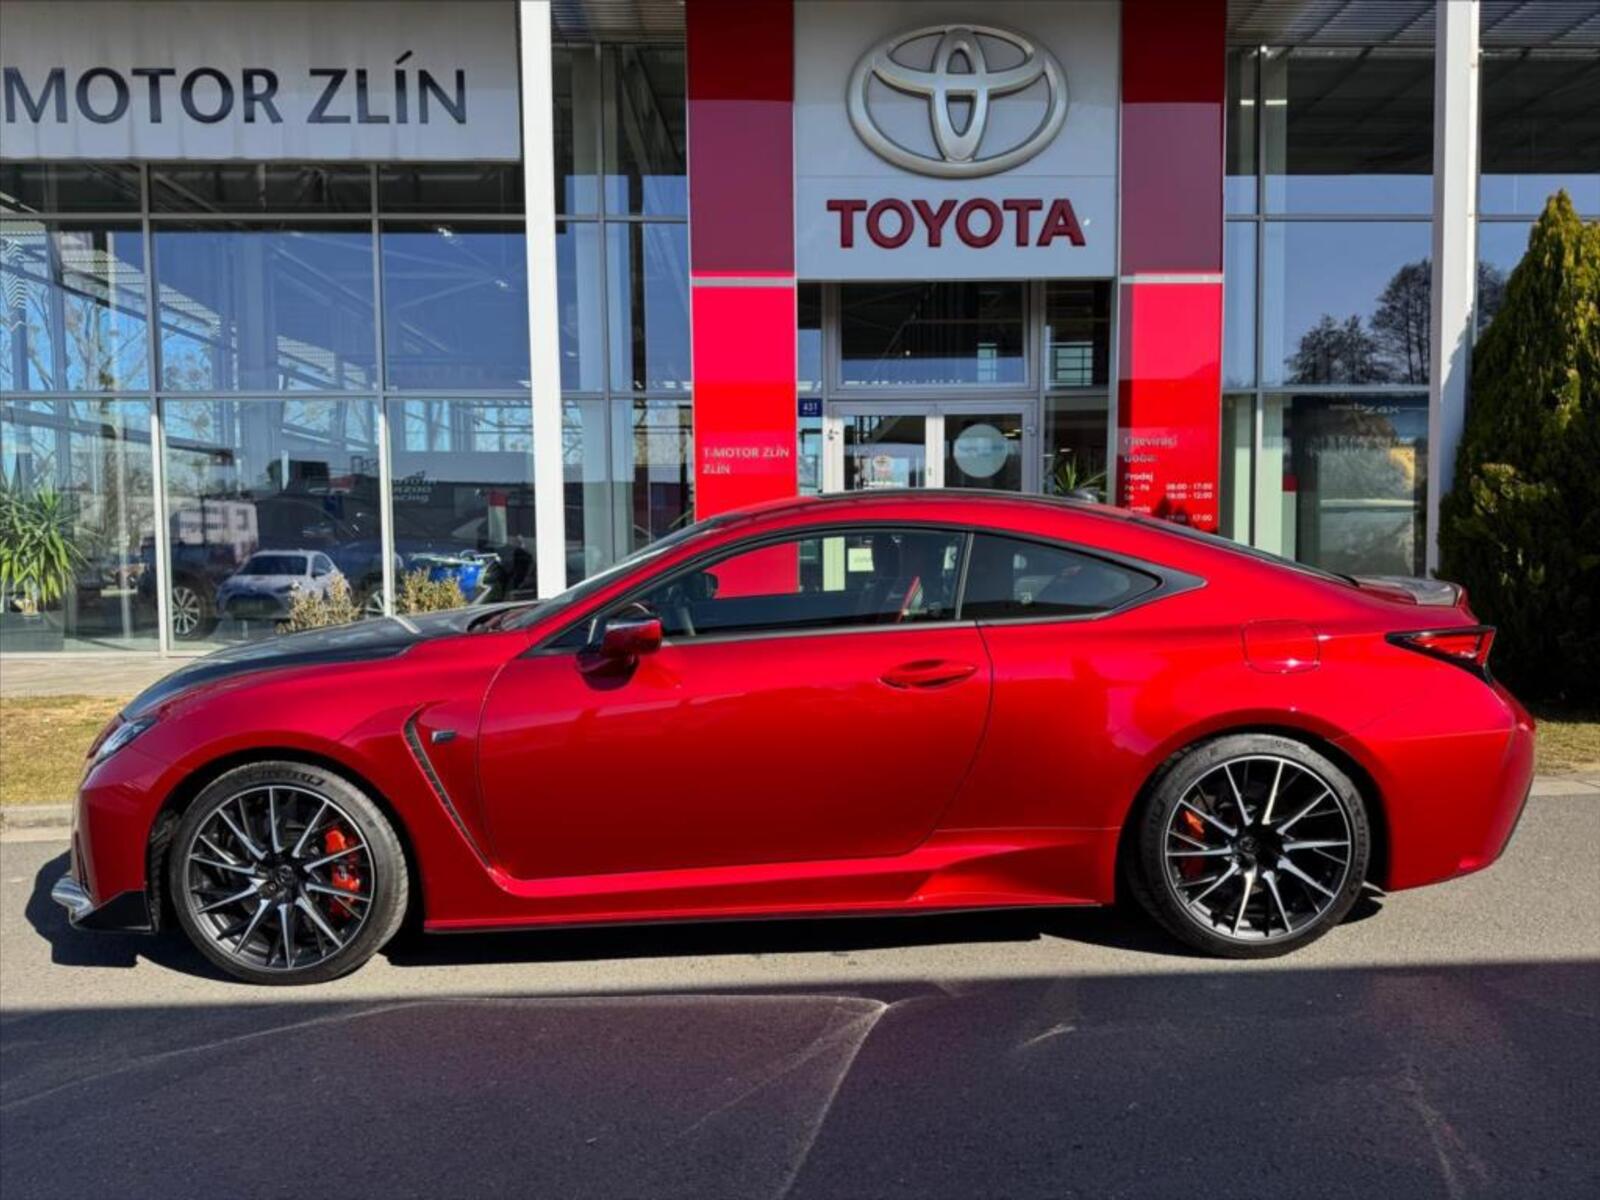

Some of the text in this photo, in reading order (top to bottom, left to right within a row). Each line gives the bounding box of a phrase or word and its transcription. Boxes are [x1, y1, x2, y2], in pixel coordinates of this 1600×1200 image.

[3, 50, 467, 124] MOTOR ZLÍN
[826, 198, 1086, 249] TOYOTA
[763, 443, 790, 458] ZLÍN
[702, 462, 730, 475] ZLÍN
